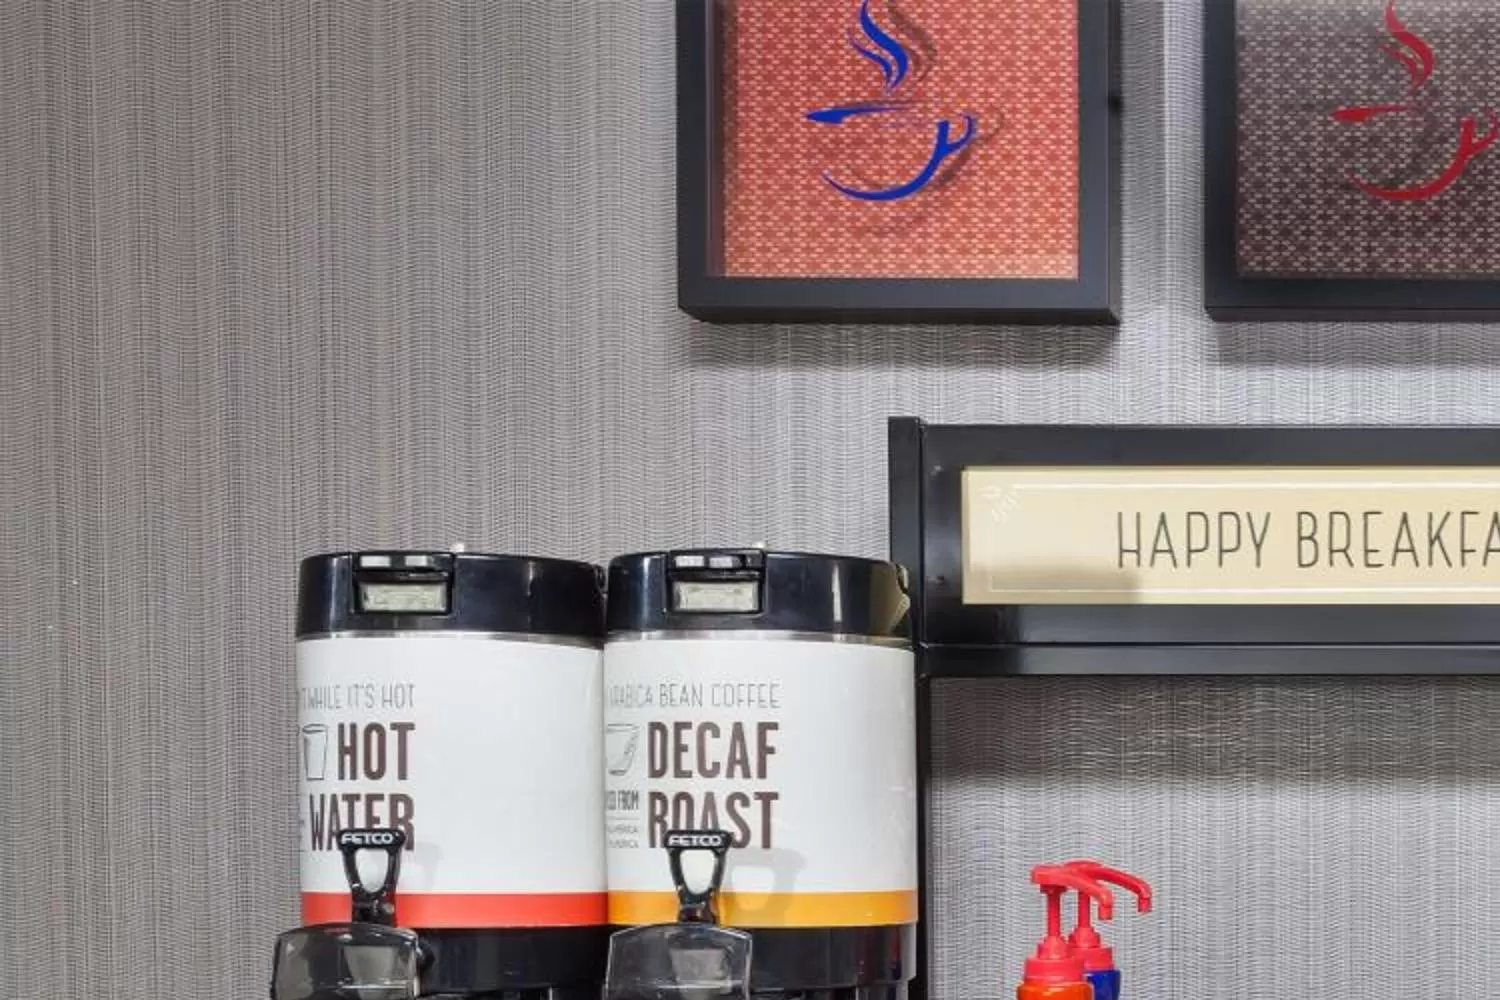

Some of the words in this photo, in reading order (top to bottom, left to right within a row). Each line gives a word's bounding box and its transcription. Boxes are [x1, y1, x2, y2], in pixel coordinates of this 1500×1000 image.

[1117, 511, 1271, 569] HAPPY
[348, 683, 376, 709] IT'S
[381, 683, 417, 709] HOT
[659, 683, 703, 708] BEAN
[711, 683, 781, 709] COFFEE
[337, 722, 416, 781] HOT
[647, 721, 779, 779] DECAF
[309, 793, 416, 851] WATER
[341, 832, 394, 845] FETCO
[647, 791, 779, 849] ROAST
[668, 834, 722, 846] FETCO
